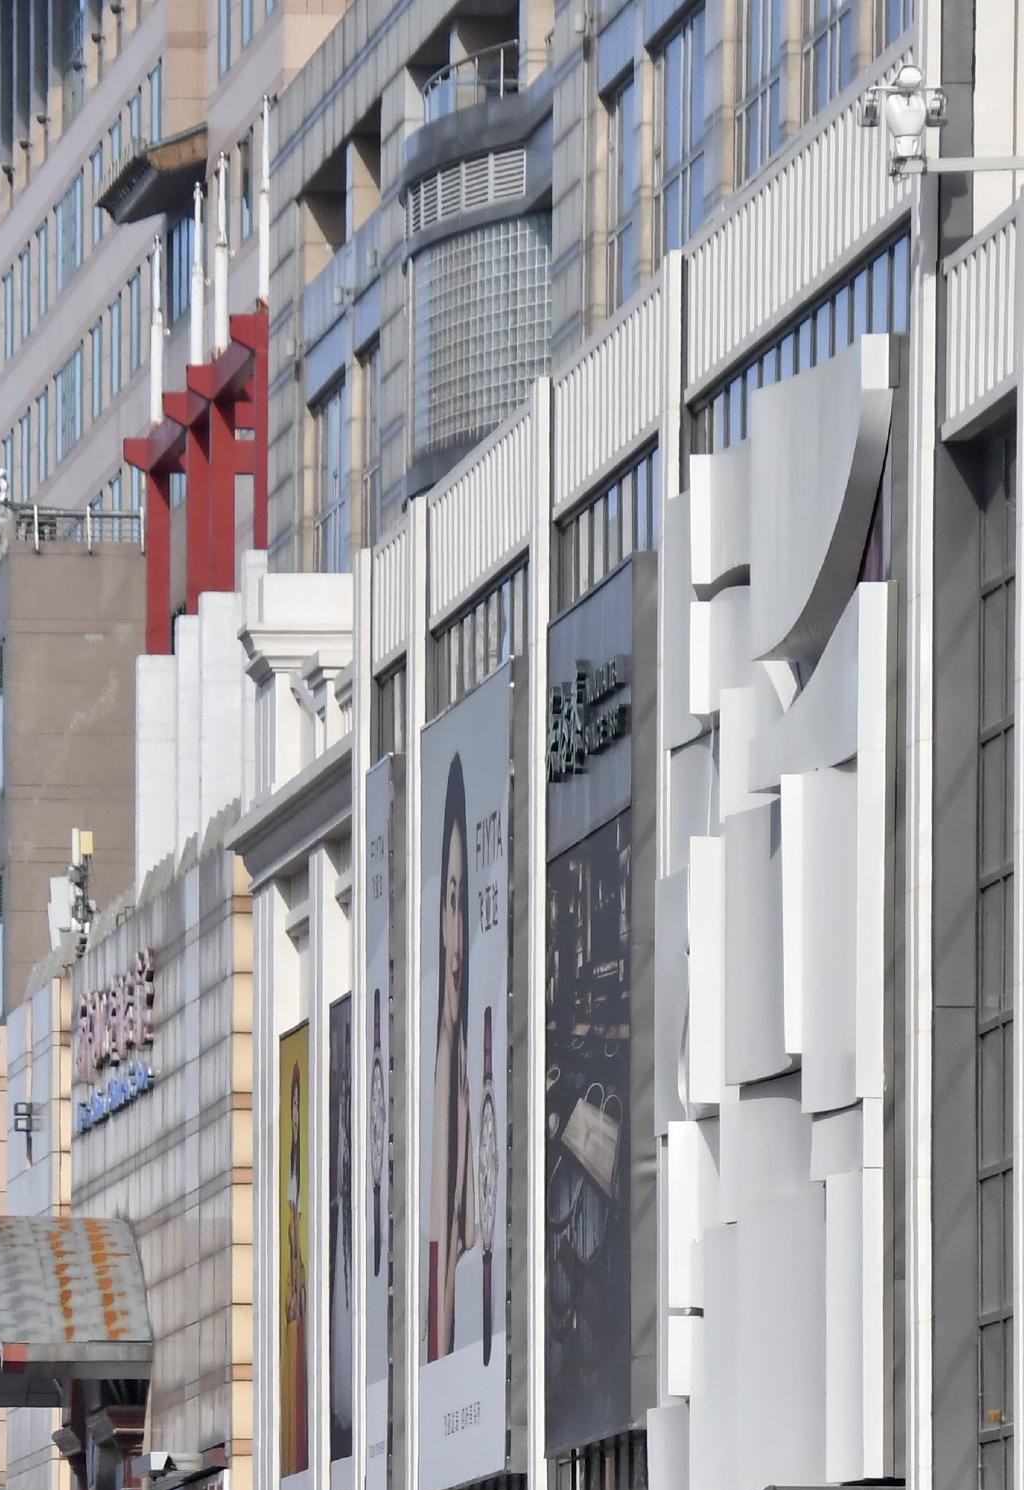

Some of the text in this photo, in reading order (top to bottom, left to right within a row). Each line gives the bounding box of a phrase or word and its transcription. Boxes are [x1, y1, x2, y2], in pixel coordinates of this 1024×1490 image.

[476, 810, 503, 873] FIYTA
[478, 881, 498, 933] 飞亚达
